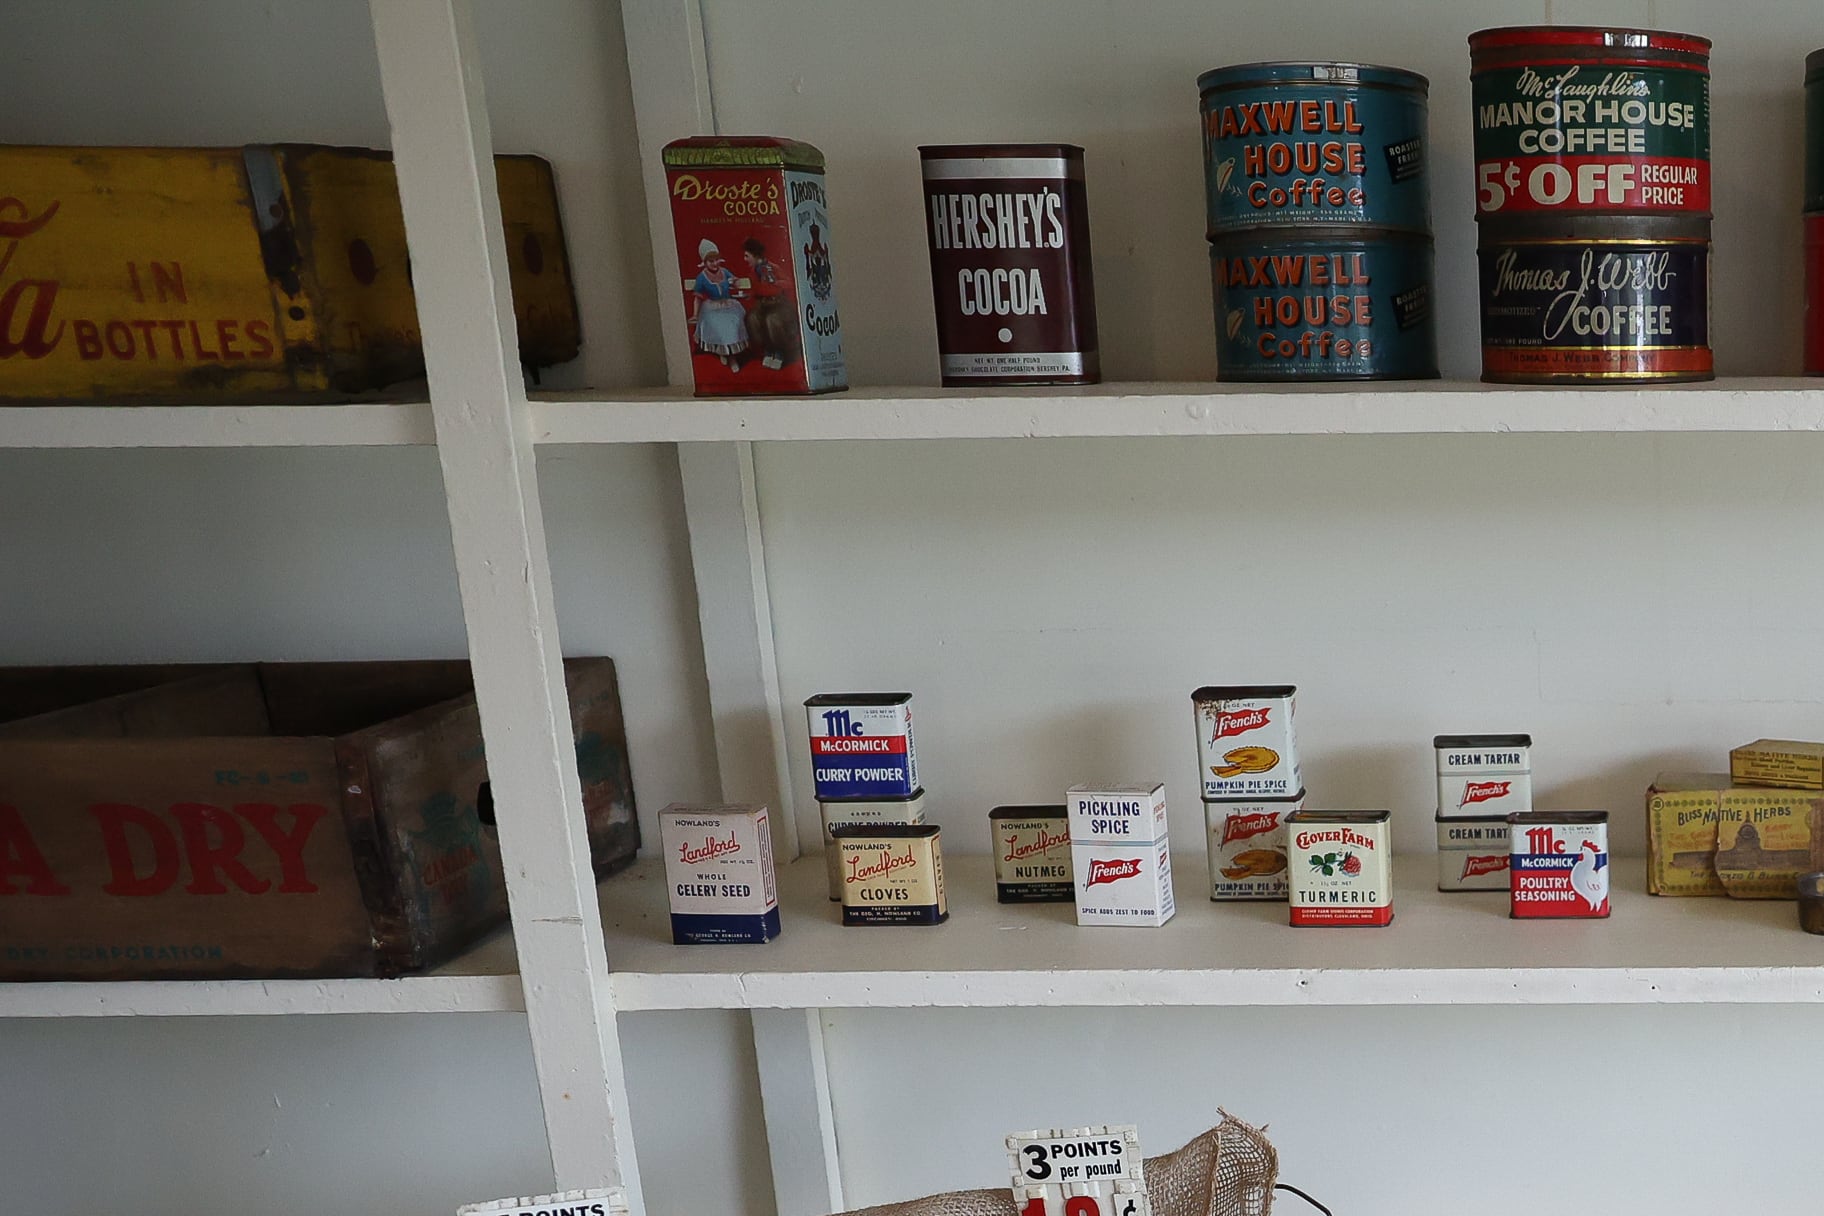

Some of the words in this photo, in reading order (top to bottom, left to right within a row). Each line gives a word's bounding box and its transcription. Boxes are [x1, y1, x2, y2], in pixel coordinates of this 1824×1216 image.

[1205, 99, 1364, 141] MAXWELL
[1479, 100, 1586, 129] MANOR
[1595, 100, 1695, 129] HOUSE
[1518, 127, 1646, 154] COFFEE
[1243, 142, 1367, 178] HOUSE
[1640, 164, 1698, 186] REGULAR
[673, 173, 780, 201] Droste's
[1246, 177, 1367, 209] Coffee
[1479, 162, 1522, 212] 5¢
[1528, 163, 1636, 205] OFF
[1640, 185, 1685, 206] PRICE
[723, 200, 781, 217] COCOA
[931, 186, 1064, 250] HERSHEY'S
[1215, 254, 1372, 289] MAXWELL
[1492, 246, 1570, 297] Thomas
[127, 261, 188, 304] IN
[957, 267, 1048, 317] COCOA
[1253, 295, 1373, 327] HOUSE
[1572, 305, 1674, 336] COFFEE
[74, 318, 275, 362] BOTTLES
[1256, 330, 1373, 359] Coffee
[821, 709, 864, 737] Mc
[1218, 711, 1264, 732] French's
[820, 739, 890, 752] McCORMICK
[1448, 754, 1482, 765] CREAM
[1484, 753, 1521, 765] TARTAR
[816, 768, 852, 782] CURRY
[854, 767, 904, 781] POWDER
[1205, 781, 1245, 790] PUMPKIN
[1248, 780, 1261, 789] PIE
[1264, 780, 1287, 789] SPICE
[1466, 785, 1505, 801] French's
[1078, 800, 1141, 816] PICKLING
[1677, 808, 1703, 827] BLISS
[1702, 808, 1743, 826] NATIVE
[1753, 805, 1792, 823] HERBS
[675, 819, 721, 827] NOWLAND'S
[1000, 822, 1049, 830] NOWLAND'S
[1091, 819, 1131, 834] SPICE
[1227, 815, 1272, 836] French's
[1004, 823, 1072, 862] Landford
[1295, 831, 1341, 850] CLOVER
[1341, 827, 1375, 850] FARM
[1449, 828, 1482, 840] CREAM
[1485, 828, 1509, 839] TART
[1525, 827, 1566, 854] Mc
[89, 801, 328, 897] DRY
[678, 830, 741, 864] Landford
[842, 843, 893, 851] NOWLAND'S
[845, 844, 917, 884] Landford
[1015, 865, 1066, 879] NUTMEG
[1092, 862, 1135, 882] French's
[1466, 859, 1505, 875] French's
[1521, 858, 1574, 868] McCORMICK
[696, 873, 727, 881] WHOLE
[1214, 882, 1253, 892] PUMPKIN
[1257, 882, 1270, 891] PIE
[1273, 882, 1289, 891] SPI
[1519, 877, 1569, 889] POULTRY
[677, 883, 717, 897] CELERY
[721, 884, 751, 898] SEED
[860, 888, 909, 901] CLOVES
[1299, 890, 1377, 903] TURMERIC
[1514, 890, 1576, 902] SEASONING
[64, 944, 223, 961] CORPORATION
[1021, 1142, 1052, 1181] 3
[1050, 1139, 1123, 1160] POINTS
[1060, 1160, 1082, 1182] per
[1085, 1158, 1122, 1179] pound
